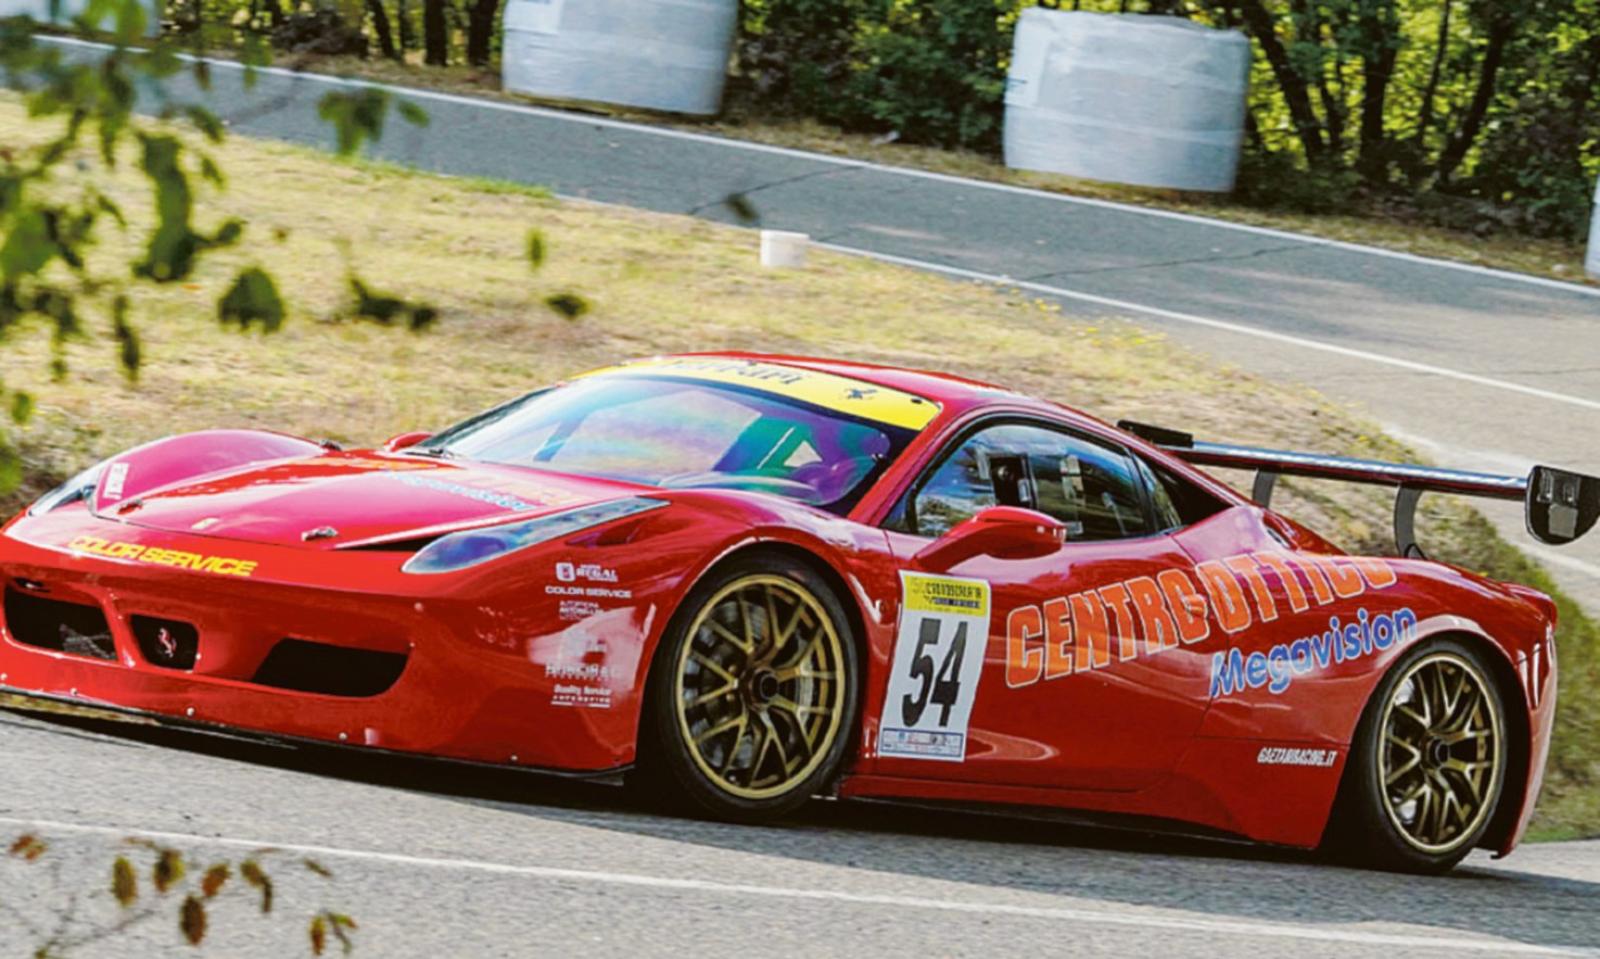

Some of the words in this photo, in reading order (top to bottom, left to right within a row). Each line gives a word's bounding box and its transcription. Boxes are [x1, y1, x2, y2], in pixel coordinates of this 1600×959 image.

[68, 535, 146, 560] COLOR
[140, 546, 259, 577] SERVICE
[545, 585, 585, 596] COLOR
[586, 588, 632, 599] SERVICE
[1005, 568, 1211, 689] CENTRO
[1197, 552, 1398, 634] OTTICO
[1209, 607, 1418, 699] Megavision
[902, 617, 969, 728] 54
